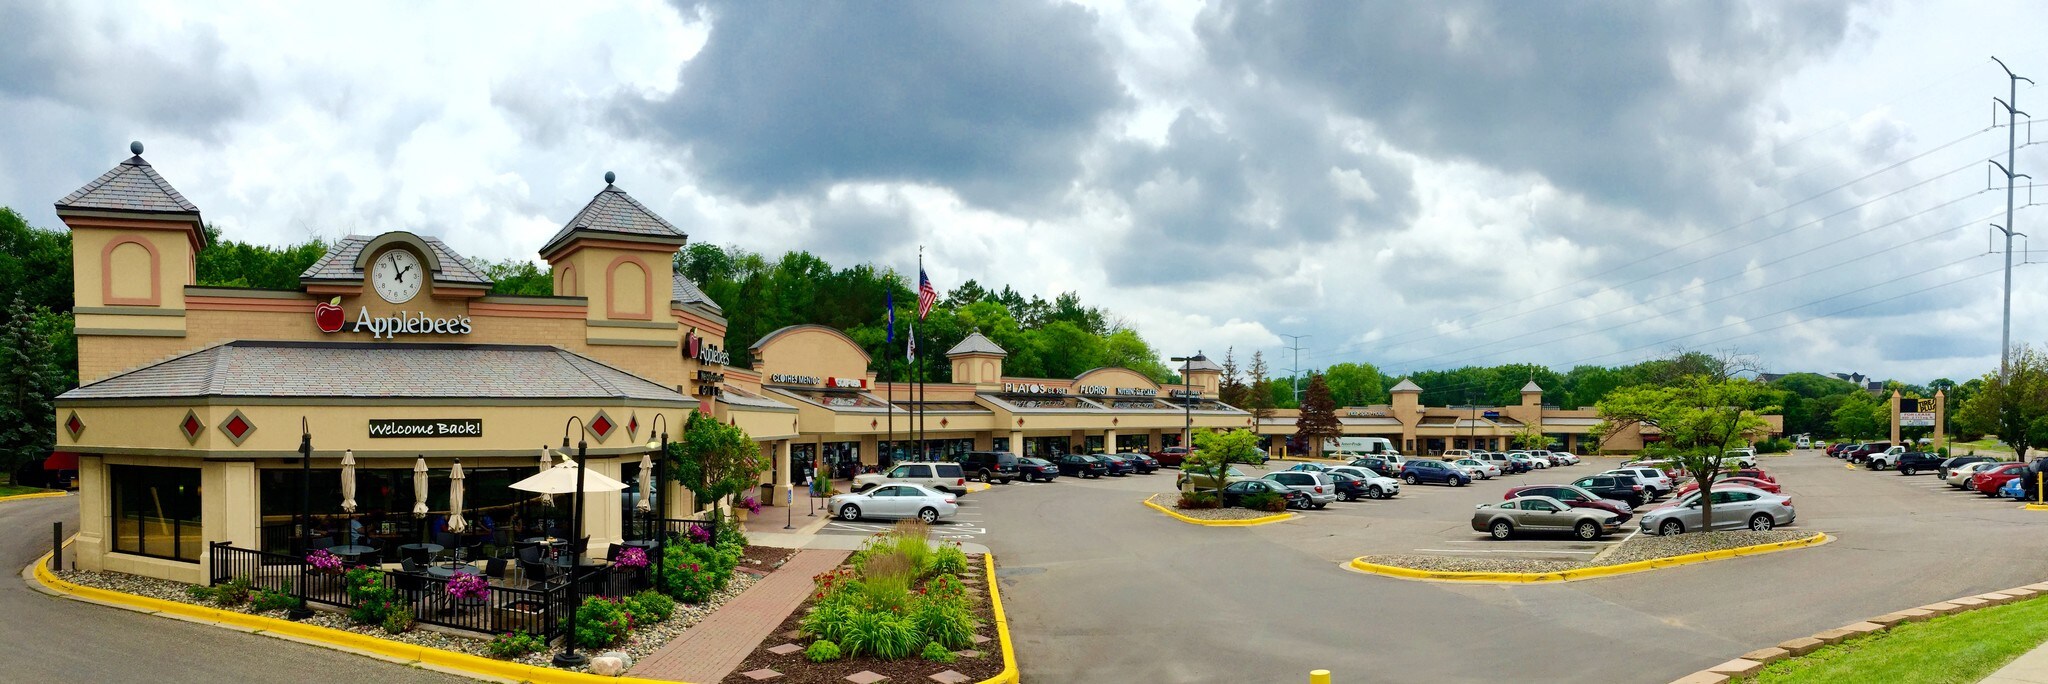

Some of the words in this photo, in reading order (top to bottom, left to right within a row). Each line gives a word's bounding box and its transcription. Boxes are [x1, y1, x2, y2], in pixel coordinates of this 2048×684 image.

[353, 306, 472, 339] Applebee's
[700, 340, 730, 366] Applebee's
[772, 373, 798, 384] CLOTHES
[798, 376, 820, 385] MENTOR
[1005, 382, 1045, 394] PLATO'S
[1080, 384, 1109, 394] FLORIST
[369, 422, 434, 434] Welcome
[436, 422, 480, 434] Back!
